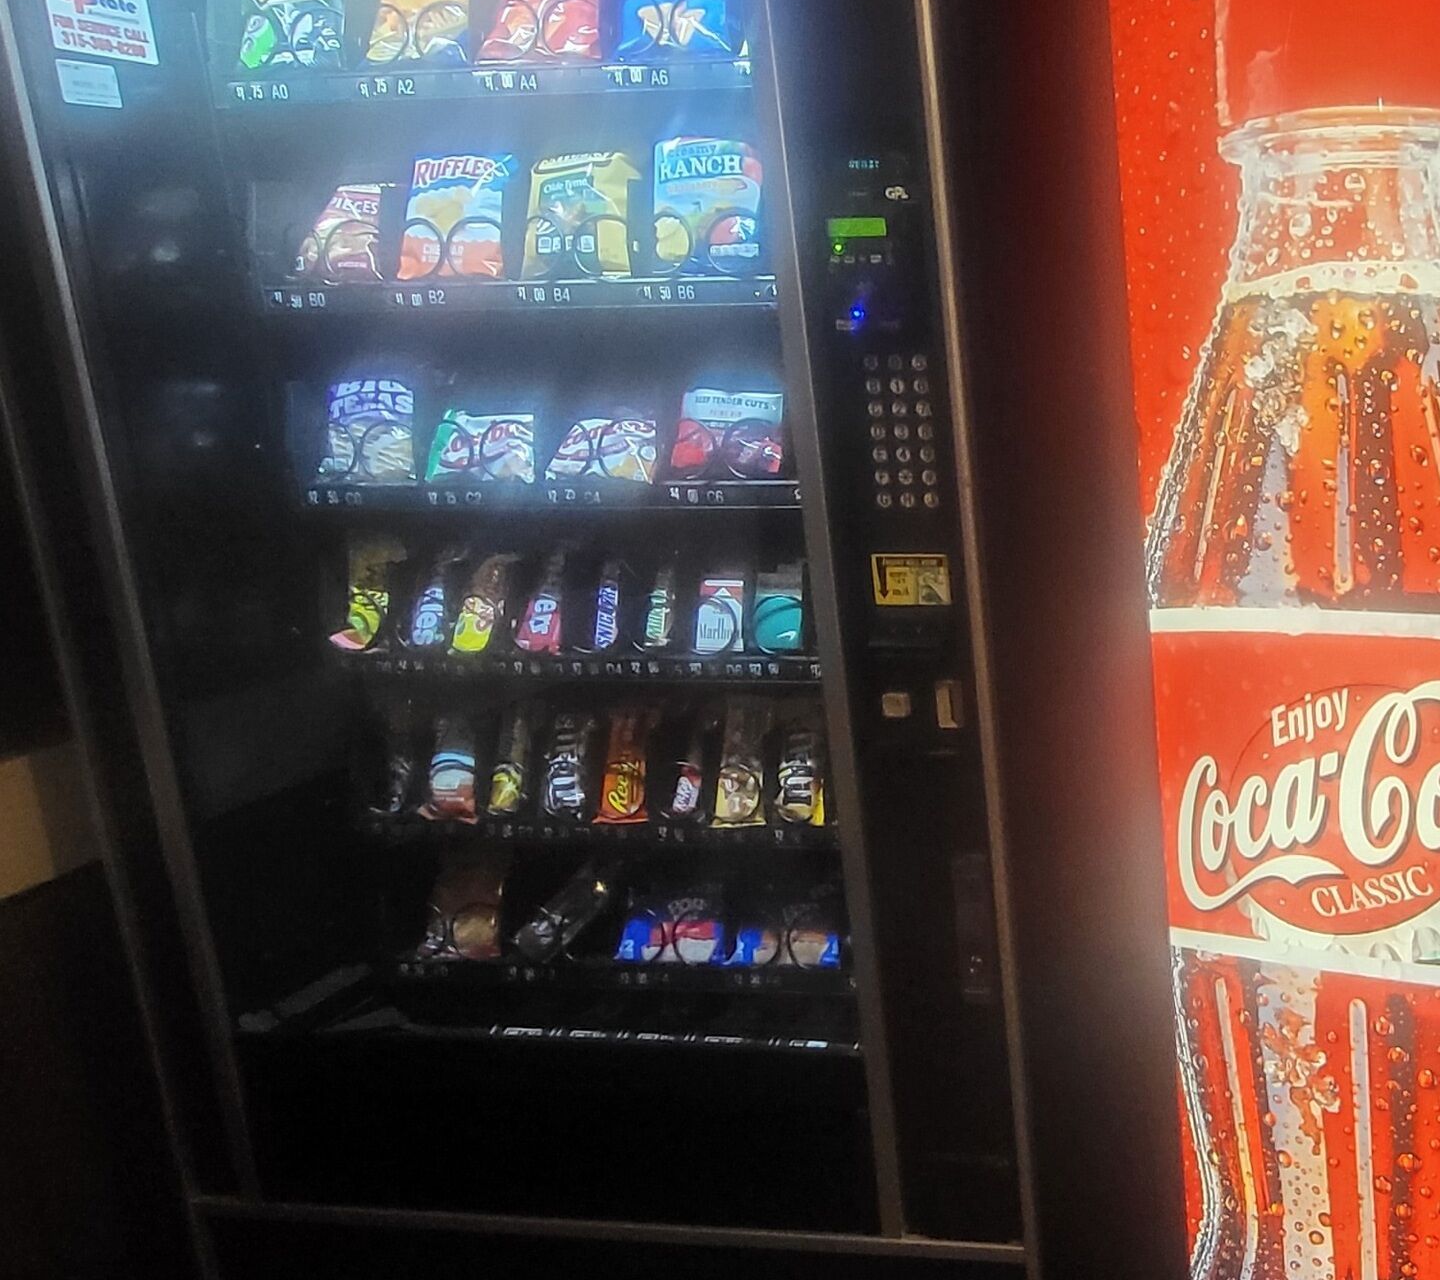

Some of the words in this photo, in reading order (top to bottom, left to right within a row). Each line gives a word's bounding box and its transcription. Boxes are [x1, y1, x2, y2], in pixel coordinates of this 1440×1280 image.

[123, 27, 149, 44] CALL
[519, 74, 538, 91] A4
[651, 69, 669, 86] A6
[271, 84, 289, 100] A0
[397, 79, 416, 95] A2
[414, 157, 499, 188] RUFFLES
[659, 154, 743, 182] RANCH
[428, 290, 446, 304] B2
[553, 287, 571, 302] B4
[677, 285, 695, 300] B6
[329, 391, 415, 419] TEXAS
[711, 396, 743, 407] TENDER
[744, 399, 770, 410] CUTS
[1271, 688, 1349, 748] Enjoy
[1310, 865, 1434, 918] CLASSIC
